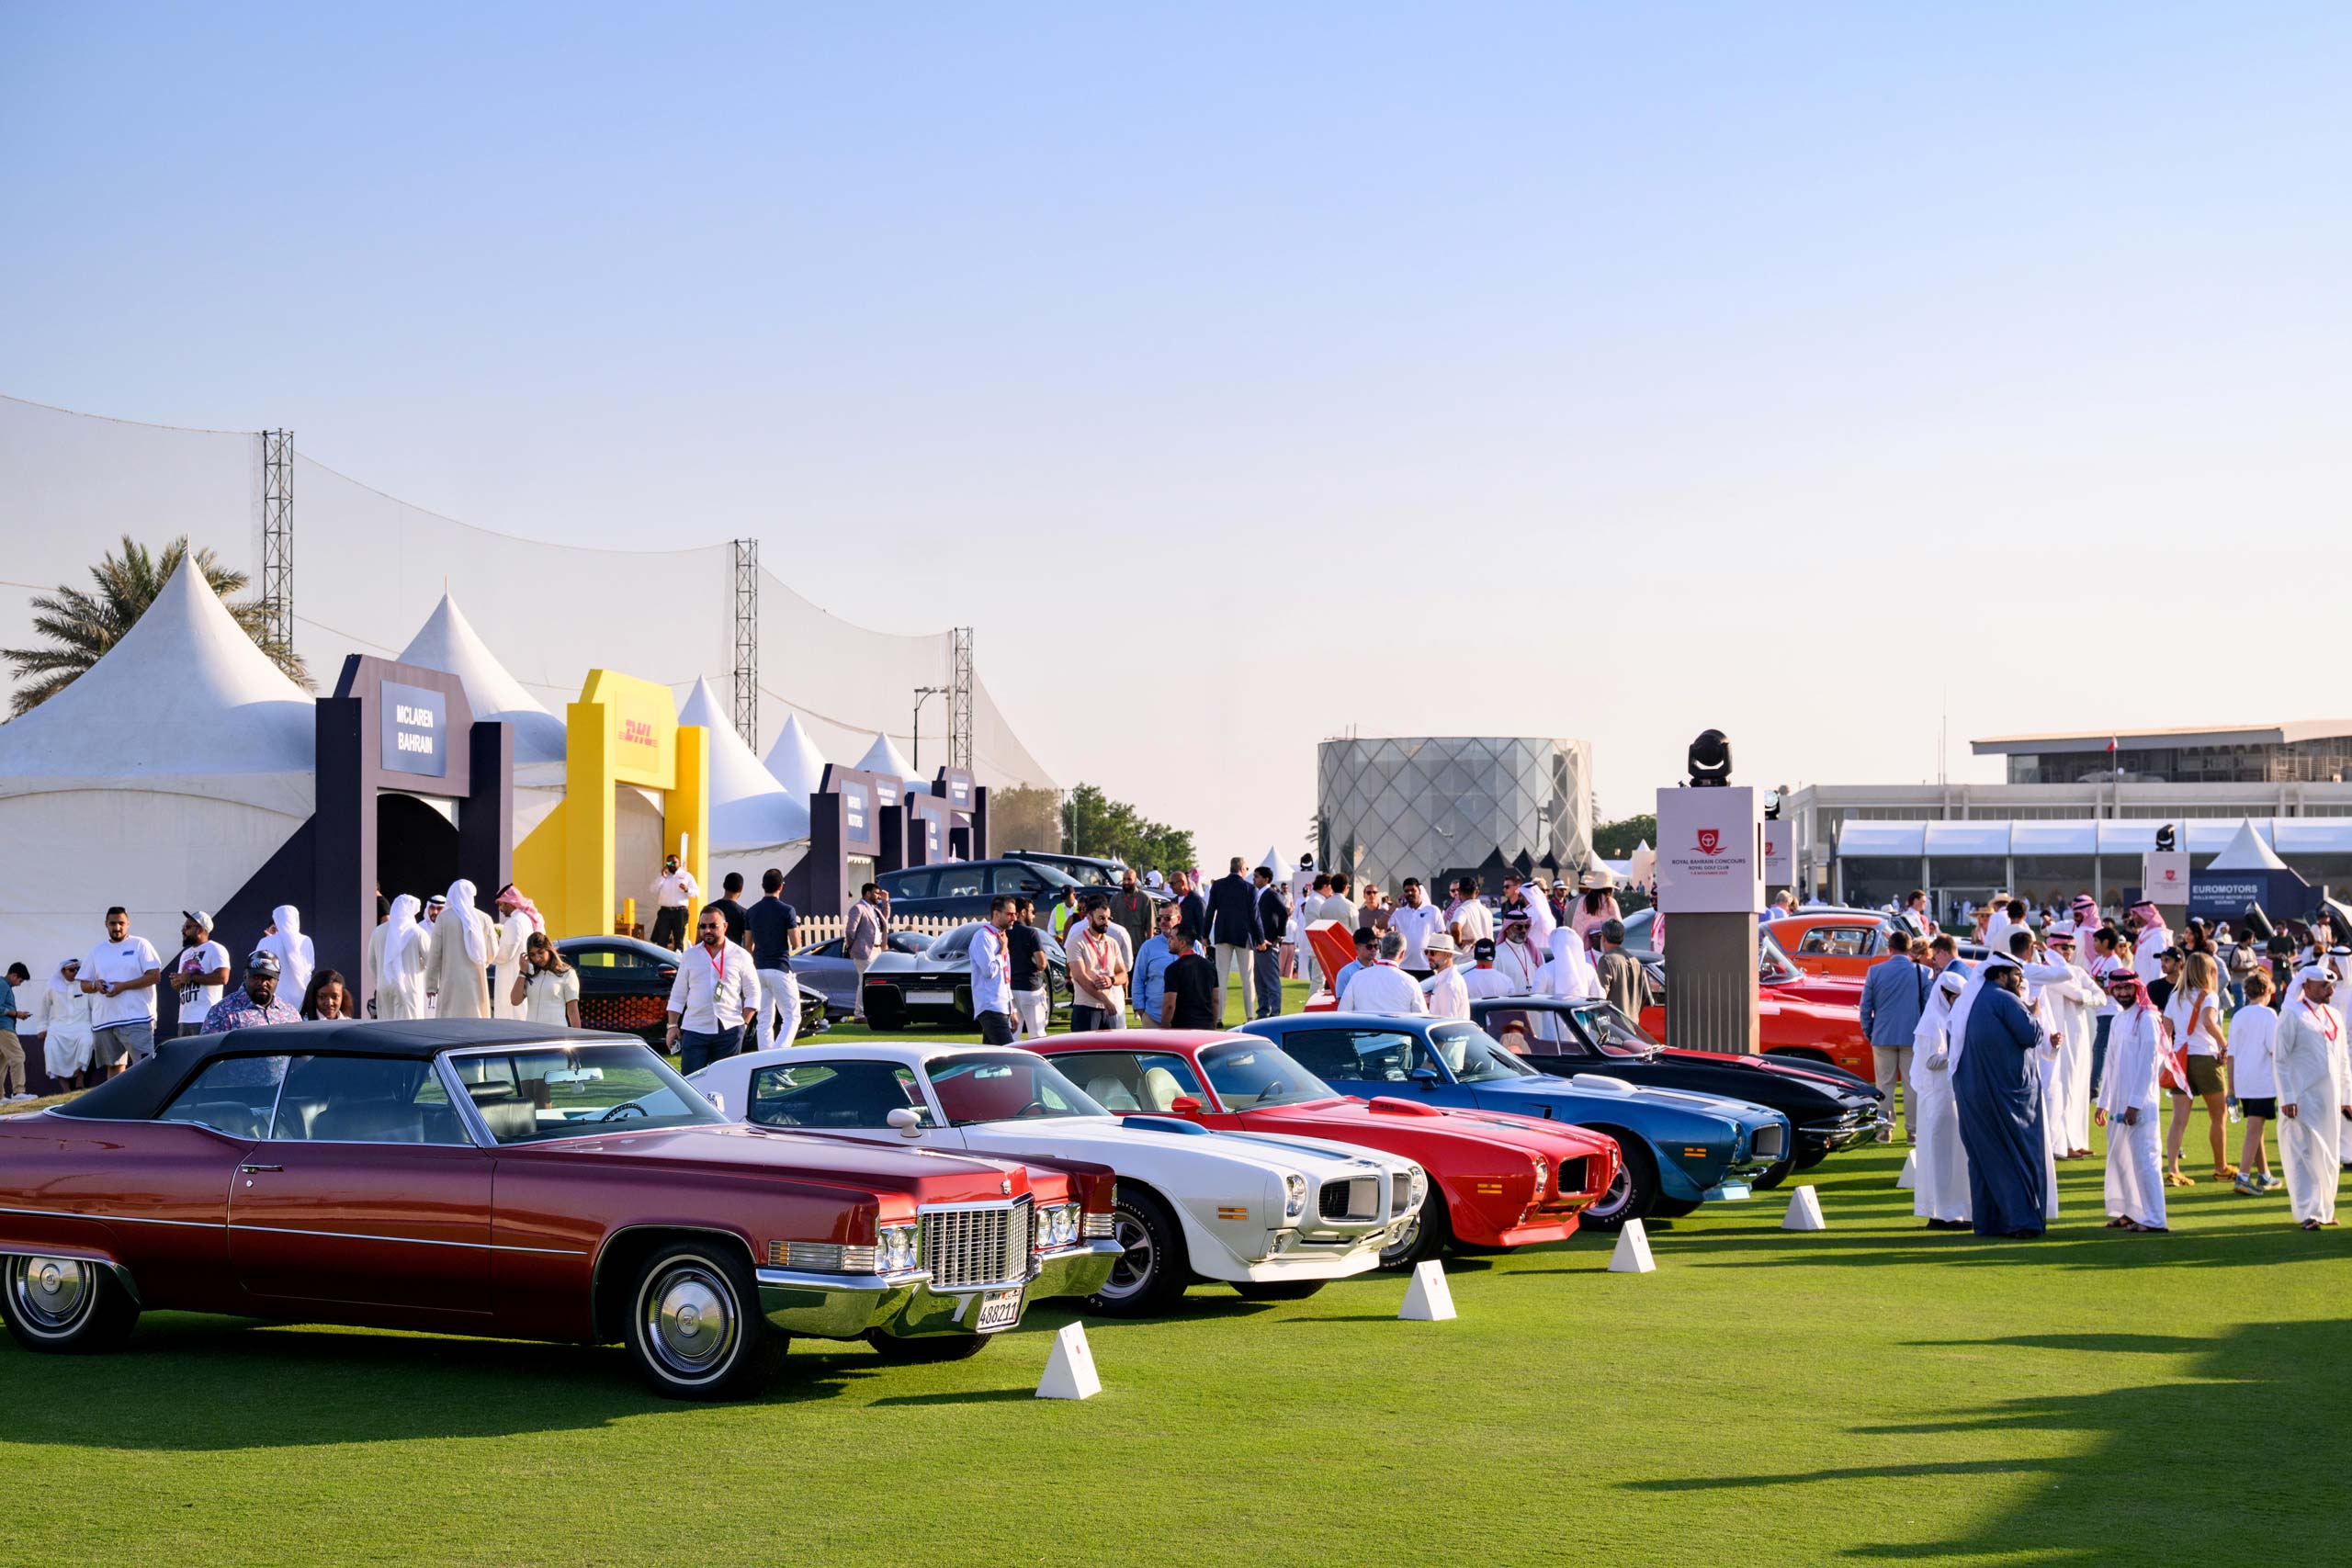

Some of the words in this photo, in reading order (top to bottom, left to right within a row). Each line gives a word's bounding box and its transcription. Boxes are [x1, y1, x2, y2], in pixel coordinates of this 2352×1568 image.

[396, 705, 434, 728] MCLAREN
[398, 732, 433, 754] BAHRAIN
[623, 719, 655, 747] DHL
[2192, 885, 2257, 894] EUROMOTORS
[980, 1302, 1017, 1325] 488211
